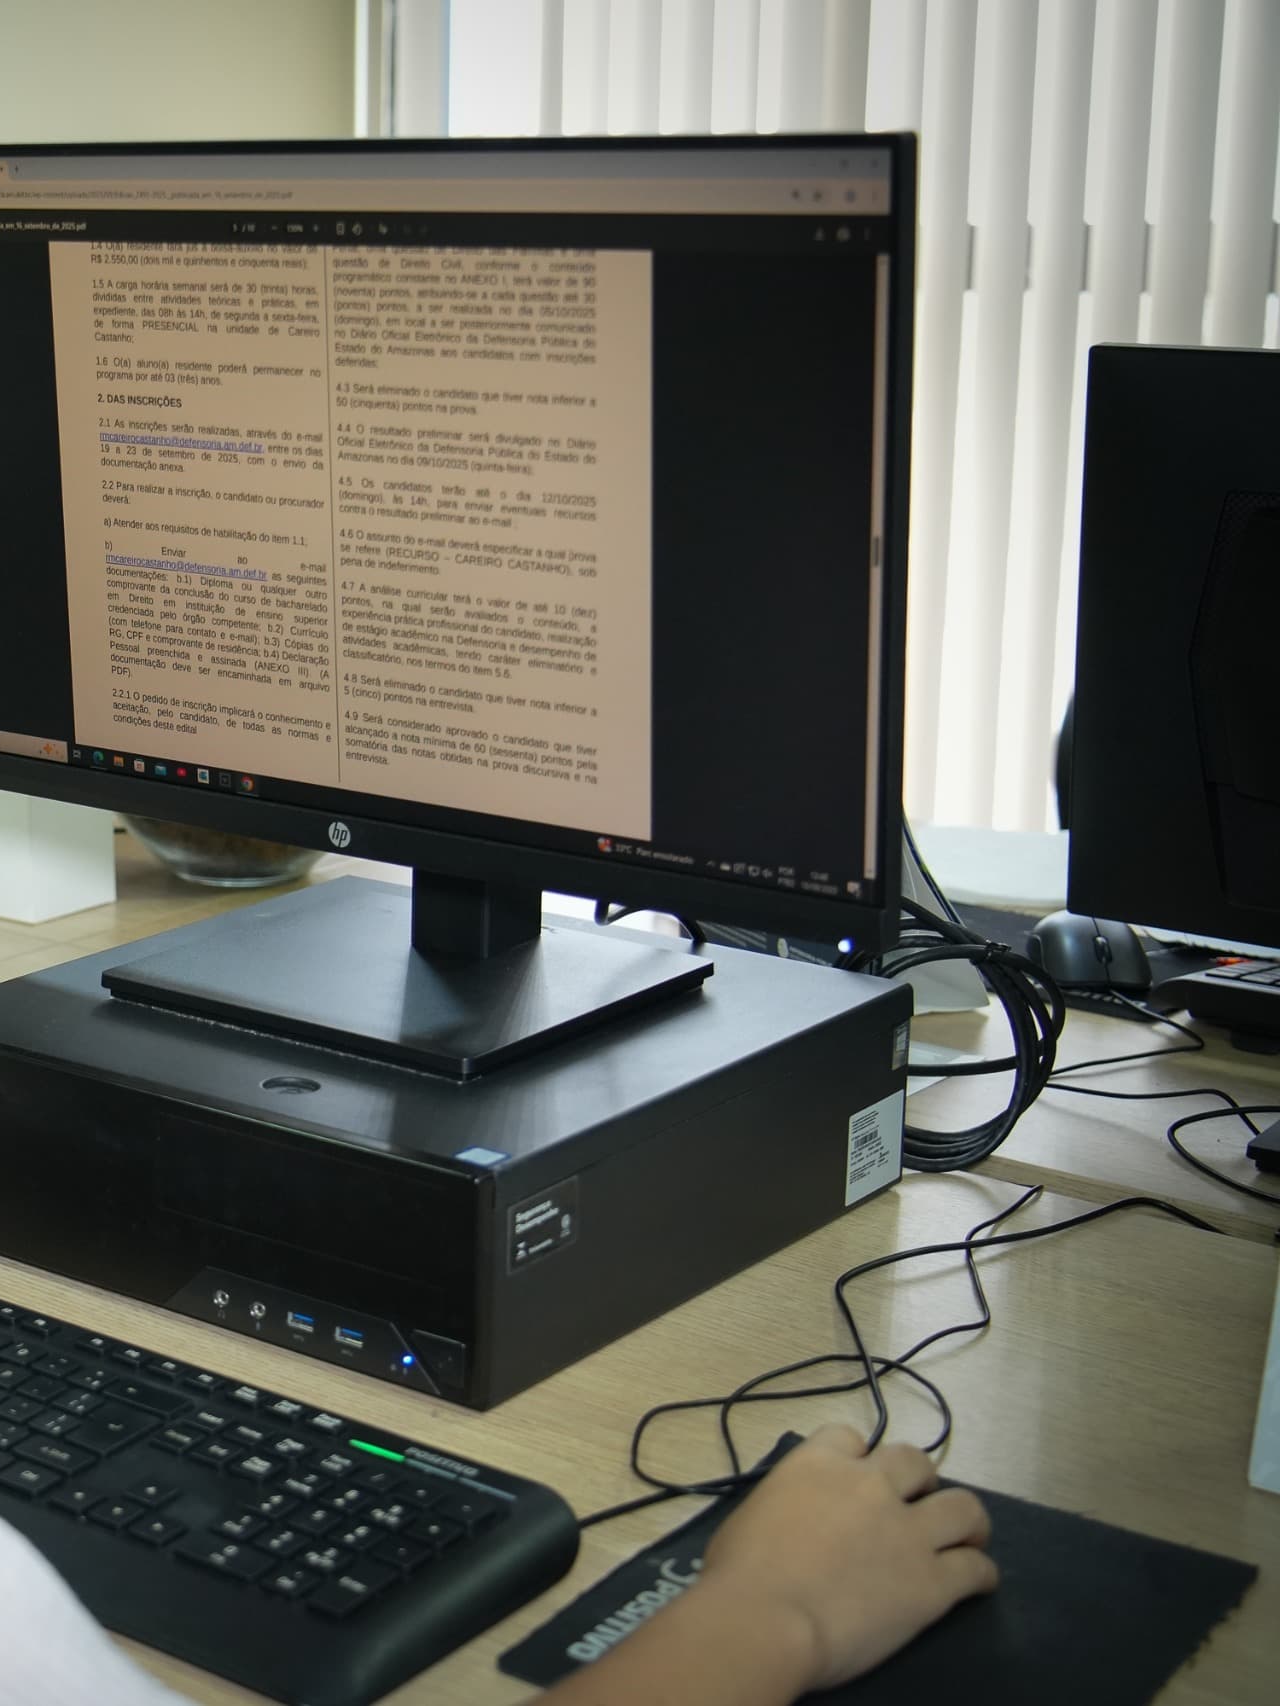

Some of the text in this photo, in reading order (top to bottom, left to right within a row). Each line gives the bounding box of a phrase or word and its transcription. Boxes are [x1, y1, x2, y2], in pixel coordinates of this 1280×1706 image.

[93, 318, 103, 328] de
[111, 318, 134, 329] forma
[141, 319, 199, 332] PRESENCIAL
[206, 323, 217, 333] na
[225, 324, 259, 334] unidade
[267, 325, 279, 335] de
[93, 331, 134, 343] Castanho;
[95, 355, 321, 377] 1.6 O(a) aluno(a) residente poderá permanecer no
[96, 370, 133, 381] programa
[134, 372, 148, 382] por
[149, 372, 163, 382] até
[164, 372, 175, 383] 03
[176, 373, 198, 385] (três)
[97, 392, 182, 408] 2. DAS INSCRIÇÕES
[98, 416, 110, 427] 2.1
[113, 418, 125, 428] As
[128, 420, 167, 432] inscrições
[171, 423, 194, 433] serão
[245, 428, 277, 439] através
[280, 430, 292, 440] do
[296, 432, 323, 442] e-mail
[100, 443, 110, 453] 19
[126, 444, 136, 455] 23
[141, 446, 152, 456] de
[157, 449, 195, 460] setembro
[200, 451, 211, 461] de
[246, 455, 265, 464] com
[282, 458, 306, 469] envio
[312, 459, 323, 470] da
[267, 444, 289, 454] entre
[291, 446, 302, 455] os
[304, 446, 323, 456] dias
[100, 456, 157, 471] documentação
[101, 479, 114, 490] 2.2
[115, 480, 134, 492] Para
[136, 483, 165, 494] realizar
[222, 492, 263, 503] candidato
[264, 495, 276, 504] ou
[278, 496, 324, 508] procurador
[103, 517, 111, 528] a)
[112, 517, 143, 529] Atender
[144, 522, 159, 531] aos
[160, 523, 199, 535] requisitos
[200, 527, 211, 536] de
[213, 527, 257, 541] habilitação
[258, 532, 270, 542] do
[104, 540, 326, 573] b) Enviar ao e-mail
[176, 573, 192, 585] b.1)
[199, 575, 233, 589] Diploma
[241, 582, 252, 591] ou
[259, 584, 296, 596] qualquer
[304, 589, 327, 600] outro
[271, 572, 282, 581] as
[285, 574, 327, 586] seguintes
[109, 639, 139, 653] Pessoal
[146, 647, 190, 660] preenchida
[210, 655, 246, 668] assinada
[254, 660, 289, 674] (ANEXO
[319, 669, 329, 680] (A
[126, 629, 143, 640] CPF
[152, 634, 203, 649] comprovante
[204, 640, 215, 650] de
[263, 648, 279, 661] b.4)
[281, 650, 329, 666] Declaração
[110, 652, 330, 692] documentação deve ser encaminhada em arquivo
[141, 693, 168, 705] pedido
[169, 697, 180, 707] de
[182, 698, 217, 713] inscrição
[219, 704, 255, 718] implicará
[265, 712, 323, 728] conhecimento
[112, 714, 197, 734] condições deste edital
[156, 708, 173, 718] pelo
[225, 717, 236, 728] de
[242, 720, 265, 732] todas
[271, 726, 281, 735] as
[287, 728, 319, 741] normas
[330, 821, 350, 848] hp
